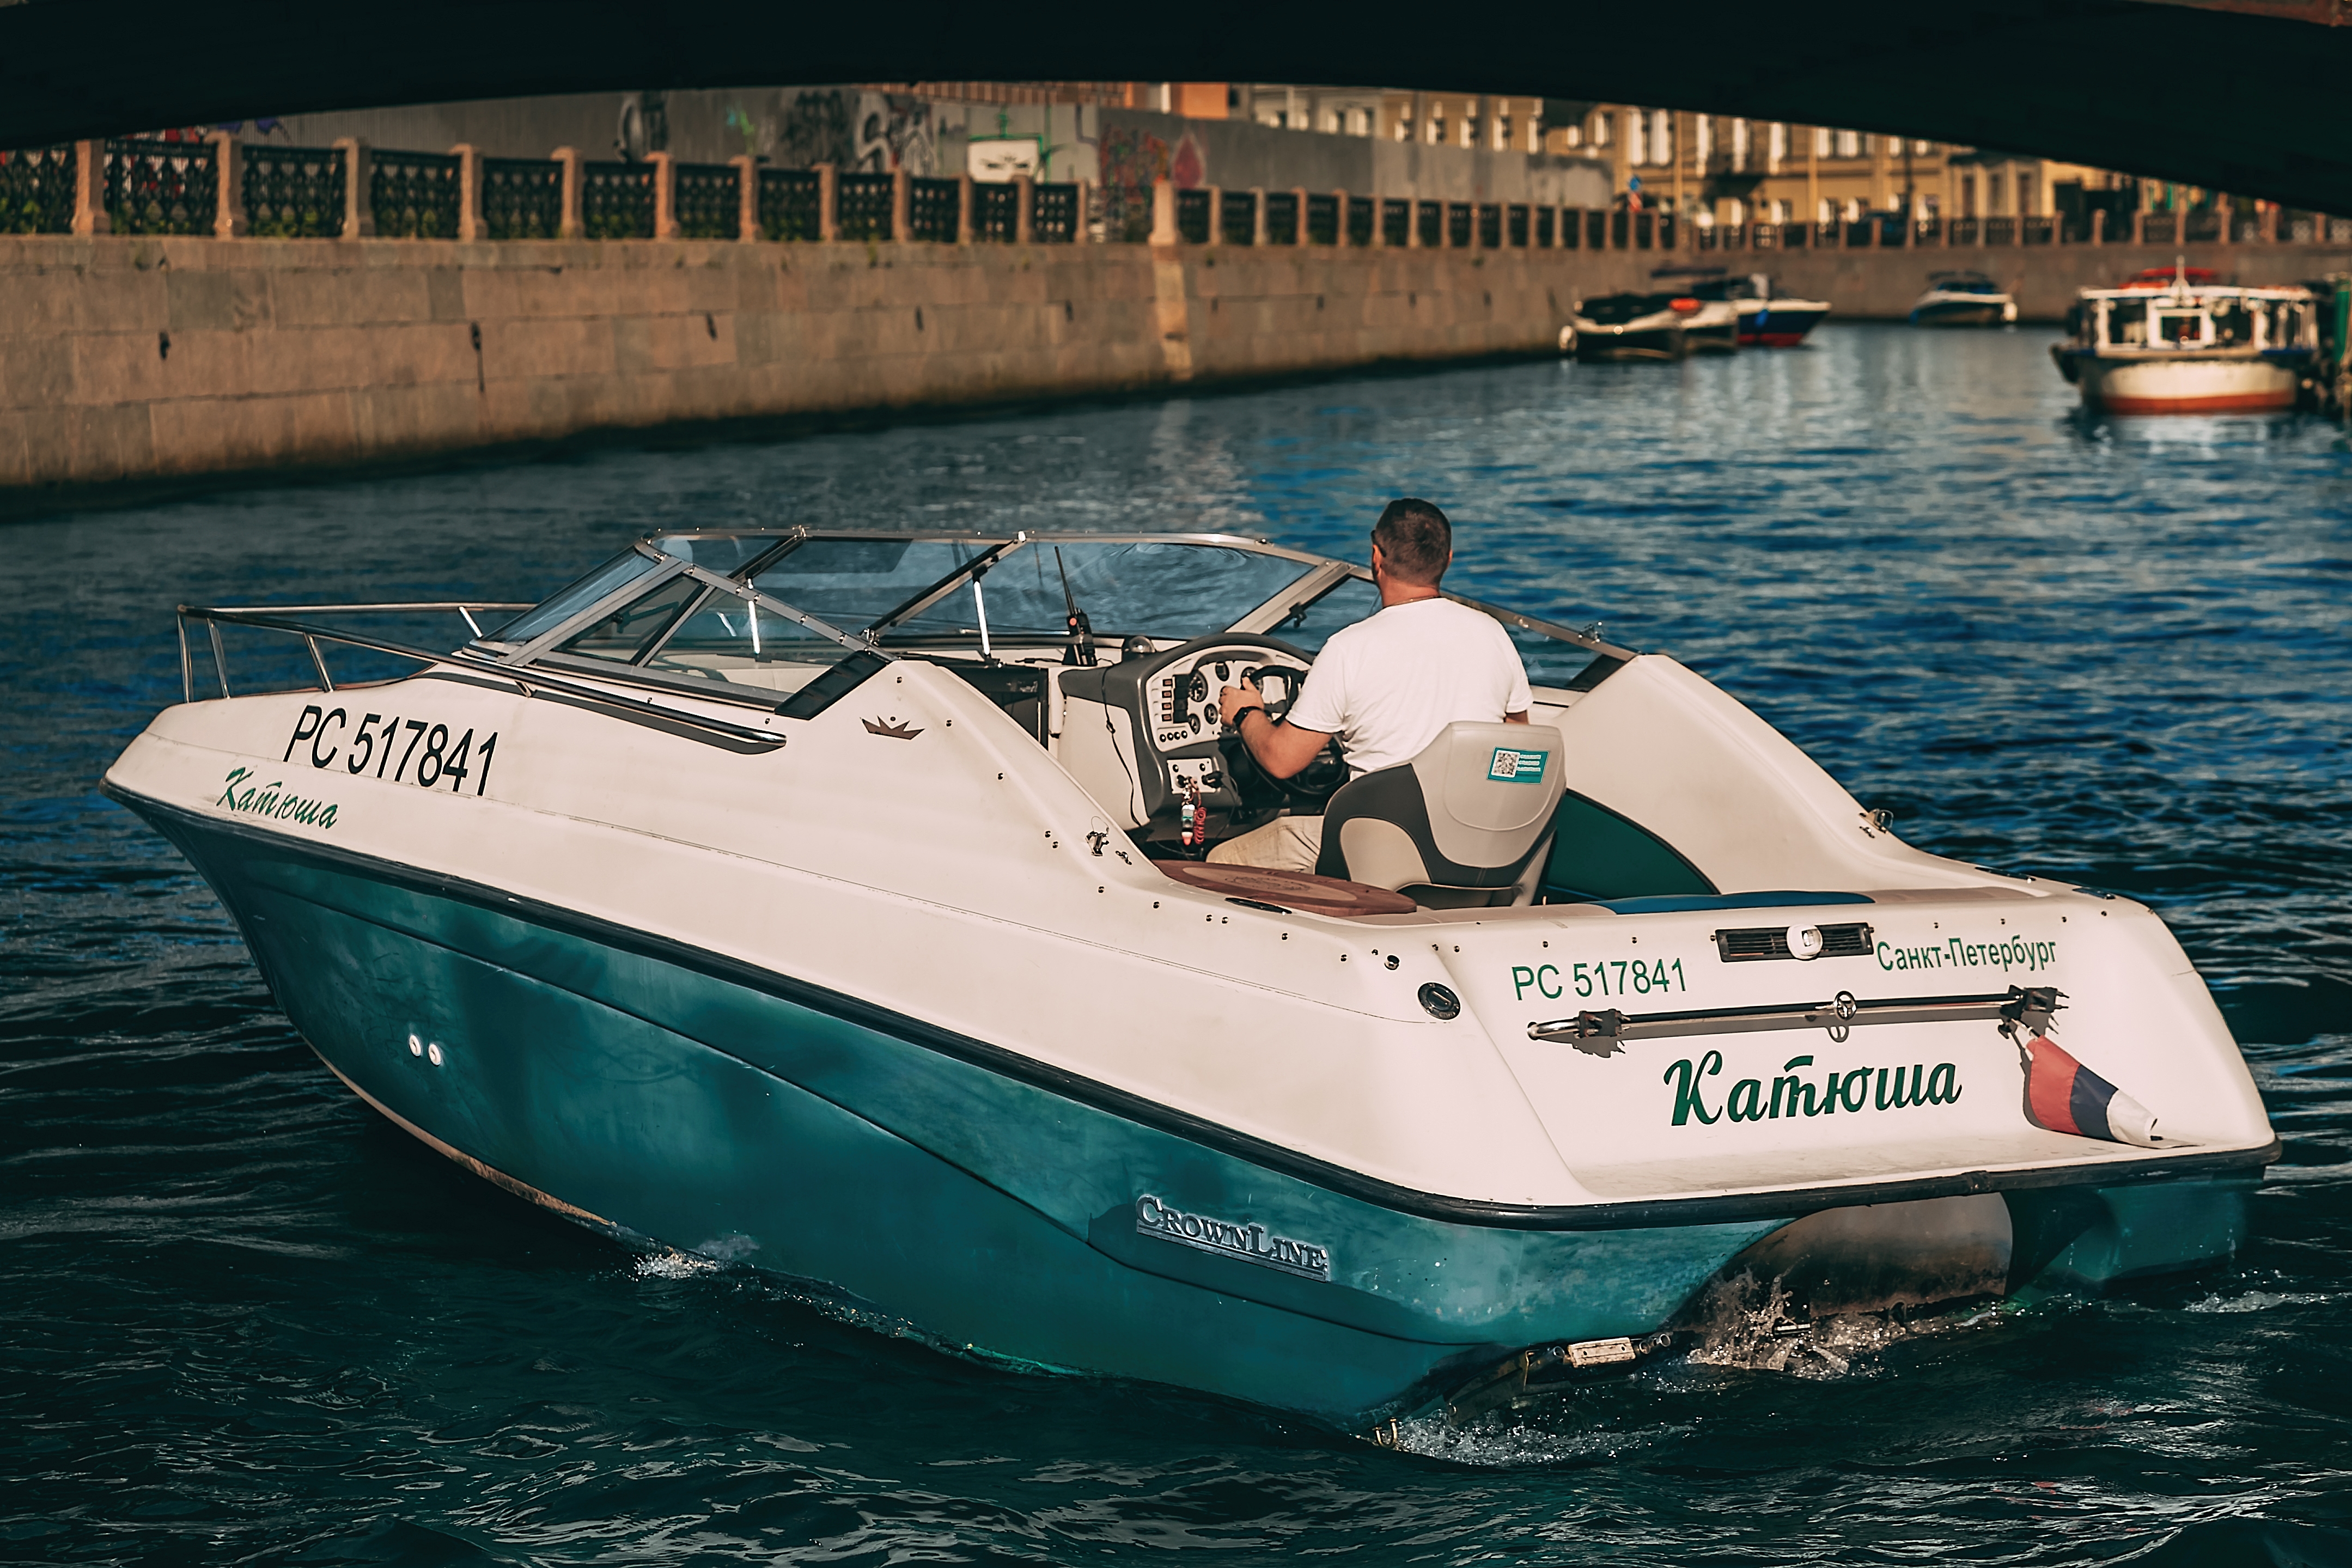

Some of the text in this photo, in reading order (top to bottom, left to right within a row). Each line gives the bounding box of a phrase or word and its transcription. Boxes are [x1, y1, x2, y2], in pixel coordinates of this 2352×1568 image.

[283, 704, 498, 797] РС 517841
[216, 766, 338, 829] Катюша
[1512, 957, 1686, 1000] РС 517841
[1877, 934, 2057, 972] Санкт-Петербург
[1663, 1050, 1963, 1126] Катюша
